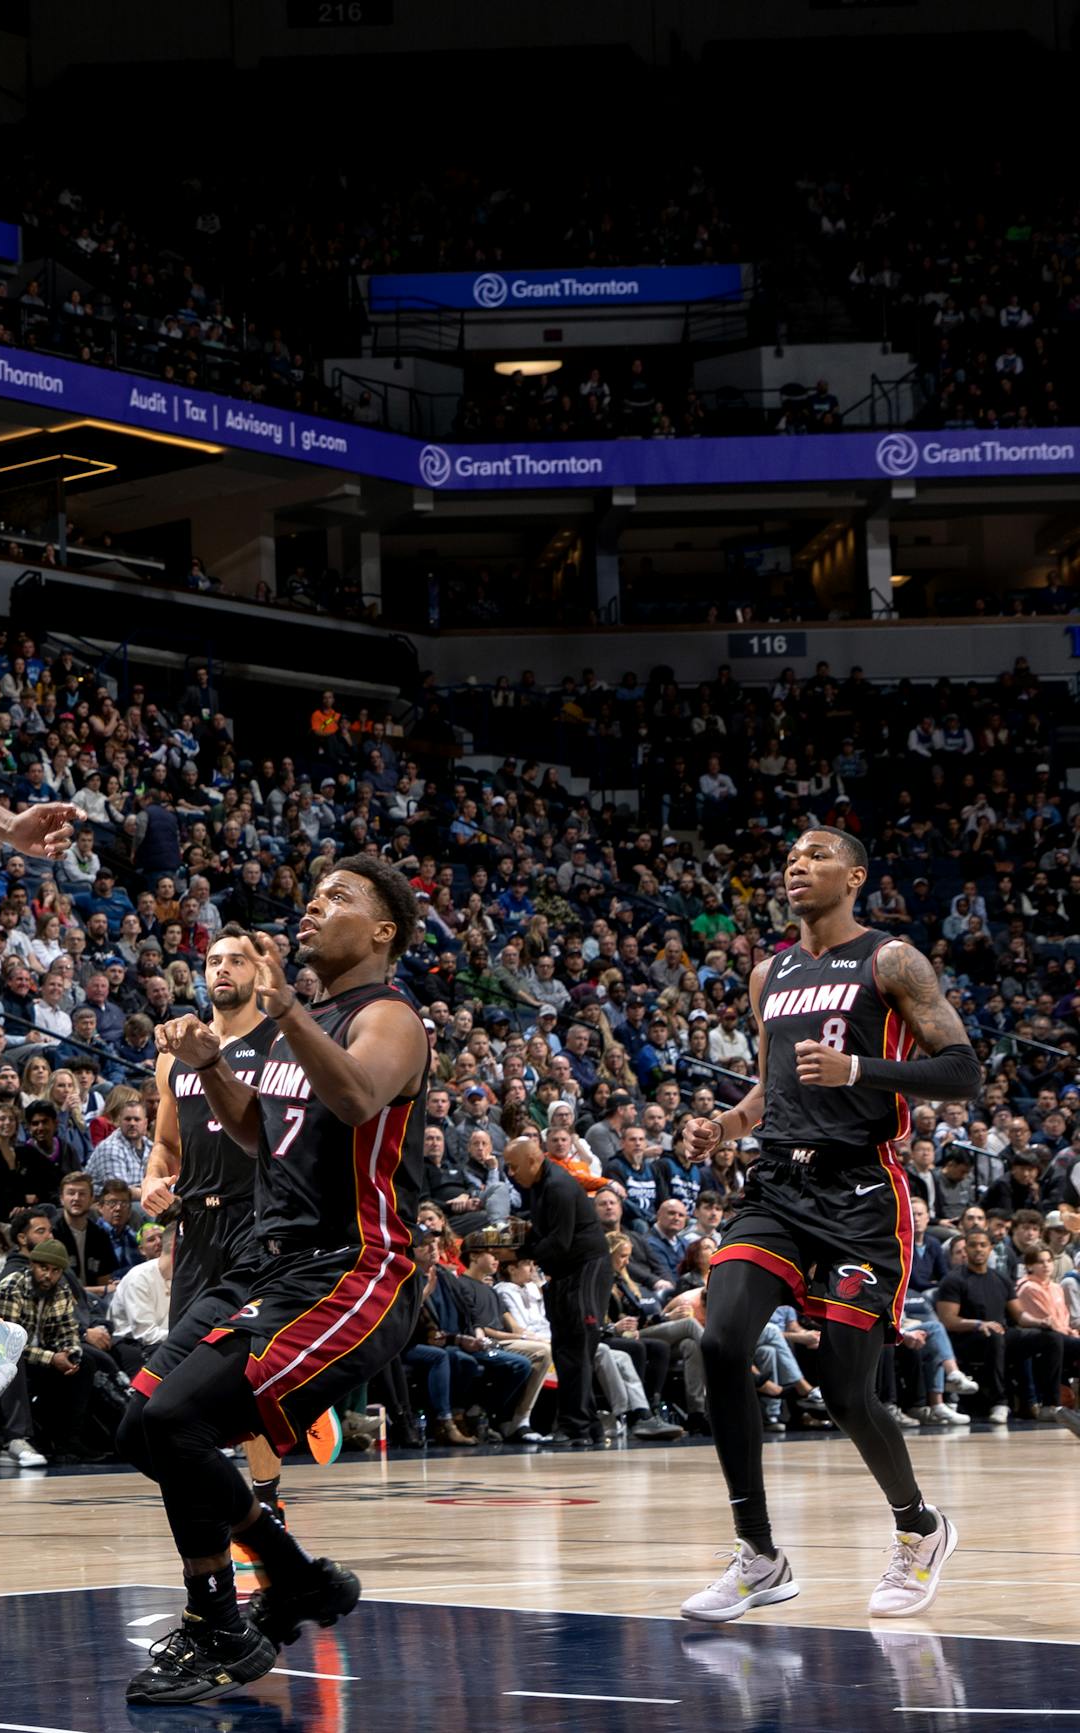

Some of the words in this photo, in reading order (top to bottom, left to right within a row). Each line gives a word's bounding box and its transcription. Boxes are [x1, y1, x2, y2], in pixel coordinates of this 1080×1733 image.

[317, 2, 362, 22] 216
[130, 388, 167, 414] Audit
[183, 400, 207, 423] Tax
[225, 409, 282, 444] Advisory
[301, 430, 347, 453] gt.com
[749, 635, 788, 654] 116
[831, 960, 857, 969] UKG
[762, 983, 862, 1022] MIAMI
[820, 1016, 847, 1053] 8
[235, 1049, 255, 1058] UKG
[273, 1105, 306, 1158] 7
